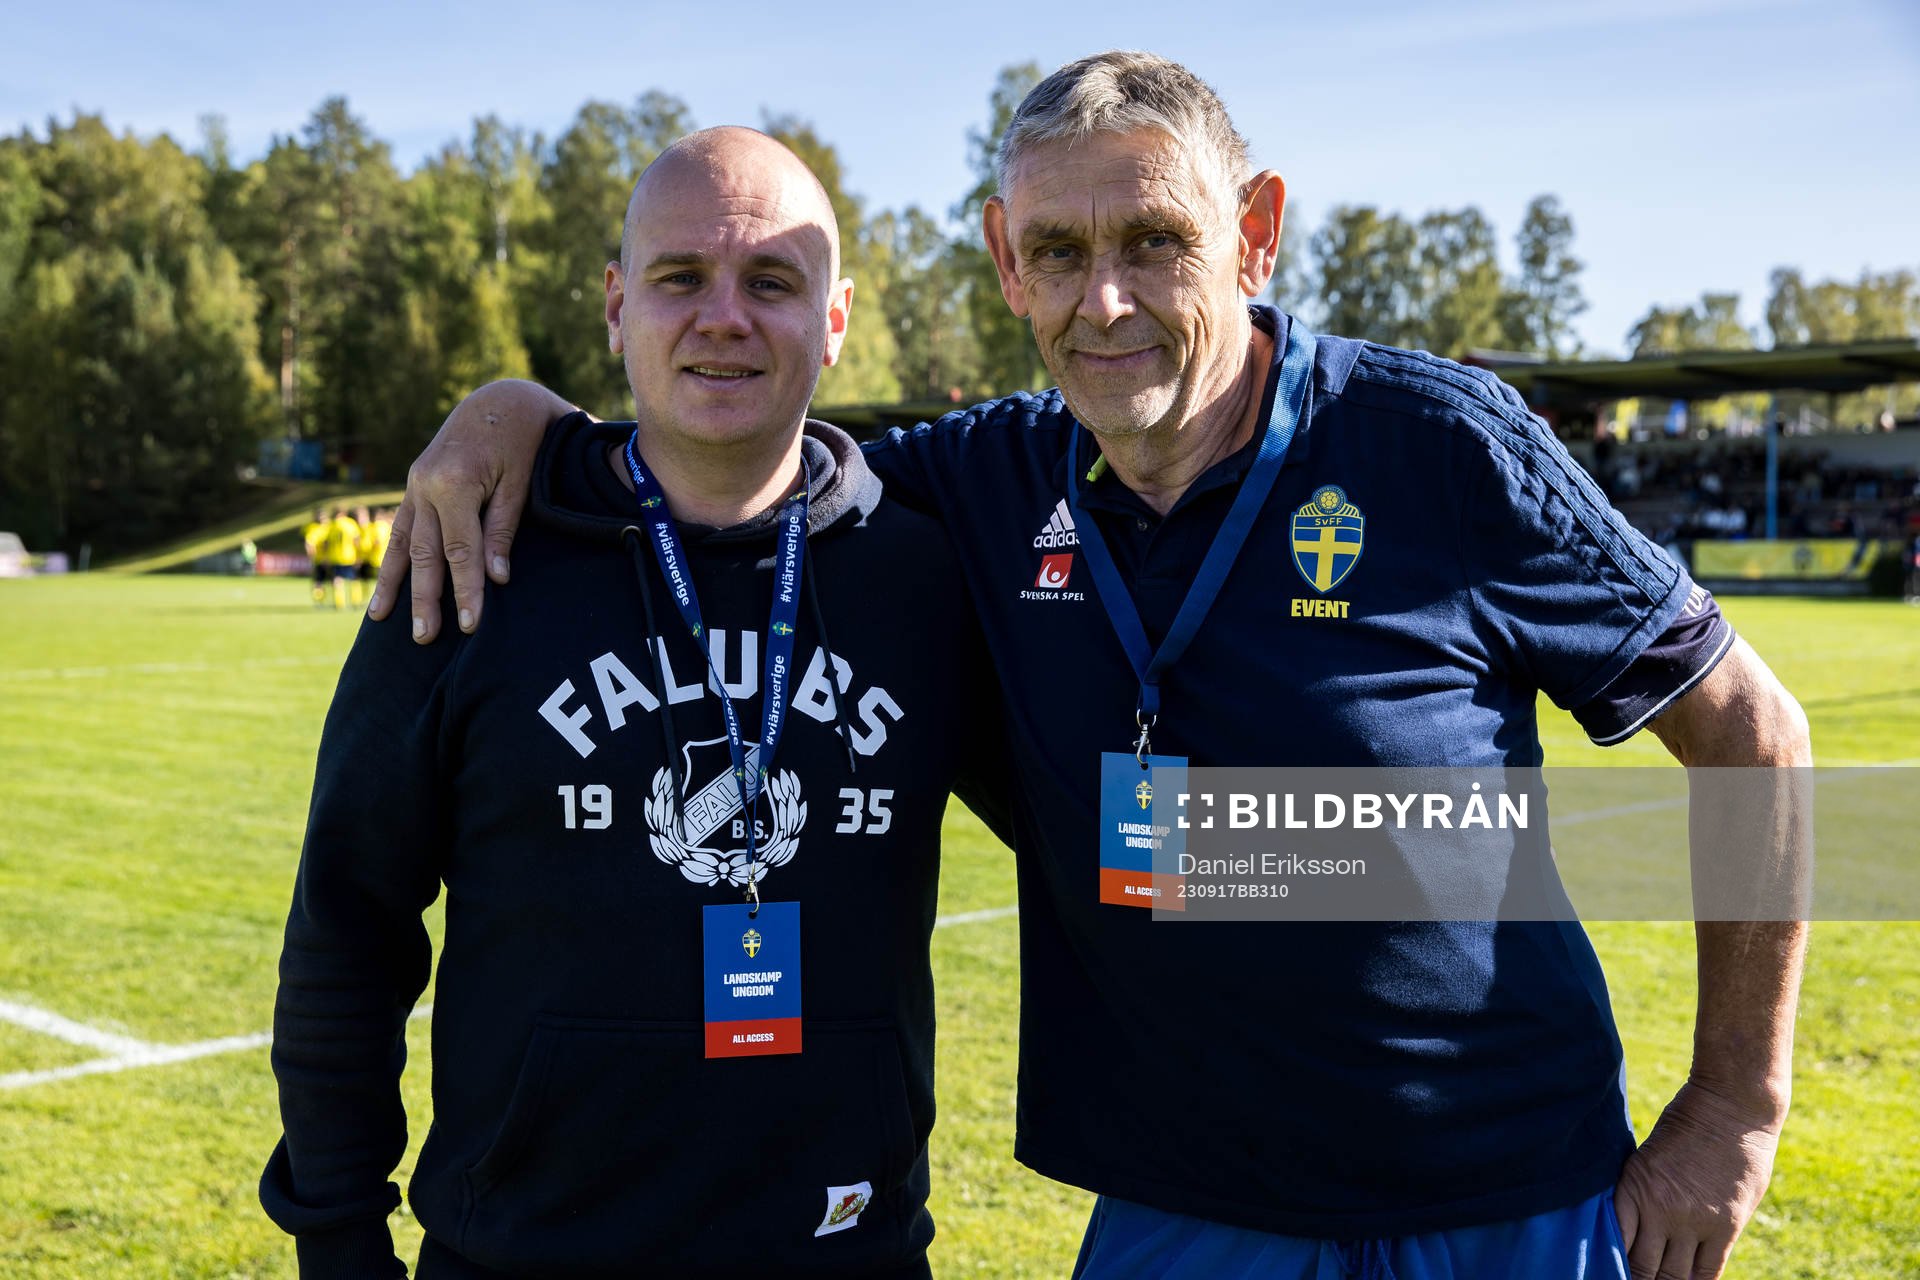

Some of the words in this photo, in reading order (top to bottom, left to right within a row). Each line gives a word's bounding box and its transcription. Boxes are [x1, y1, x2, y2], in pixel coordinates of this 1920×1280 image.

[1314, 517, 1343, 526] SvFF
[655, 522, 690, 606] #viärsverige
[780, 516, 801, 603] #viärsverige
[1019, 590, 1059, 601] SVENSKA
[1062, 592, 1085, 601] SPEL
[1290, 598, 1350, 619] EVENT
[538, 628, 758, 759] FALU
[791, 646, 905, 756] BS
[766, 655, 784, 746] #viärsverige
[557, 784, 613, 829] 19
[835, 787, 895, 835] 35
[1118, 822, 1171, 837] LANDSKAMP
[1125, 836, 1163, 850] UNGDOM
[1124, 885, 1136, 895] ALL
[1137, 886, 1162, 897] ACCESS
[723, 971, 782, 985] LANDSKAMP
[732, 985, 774, 998] UNGDOM
[732, 1034, 745, 1044] ALL
[746, 1032, 774, 1043] ACCESS
